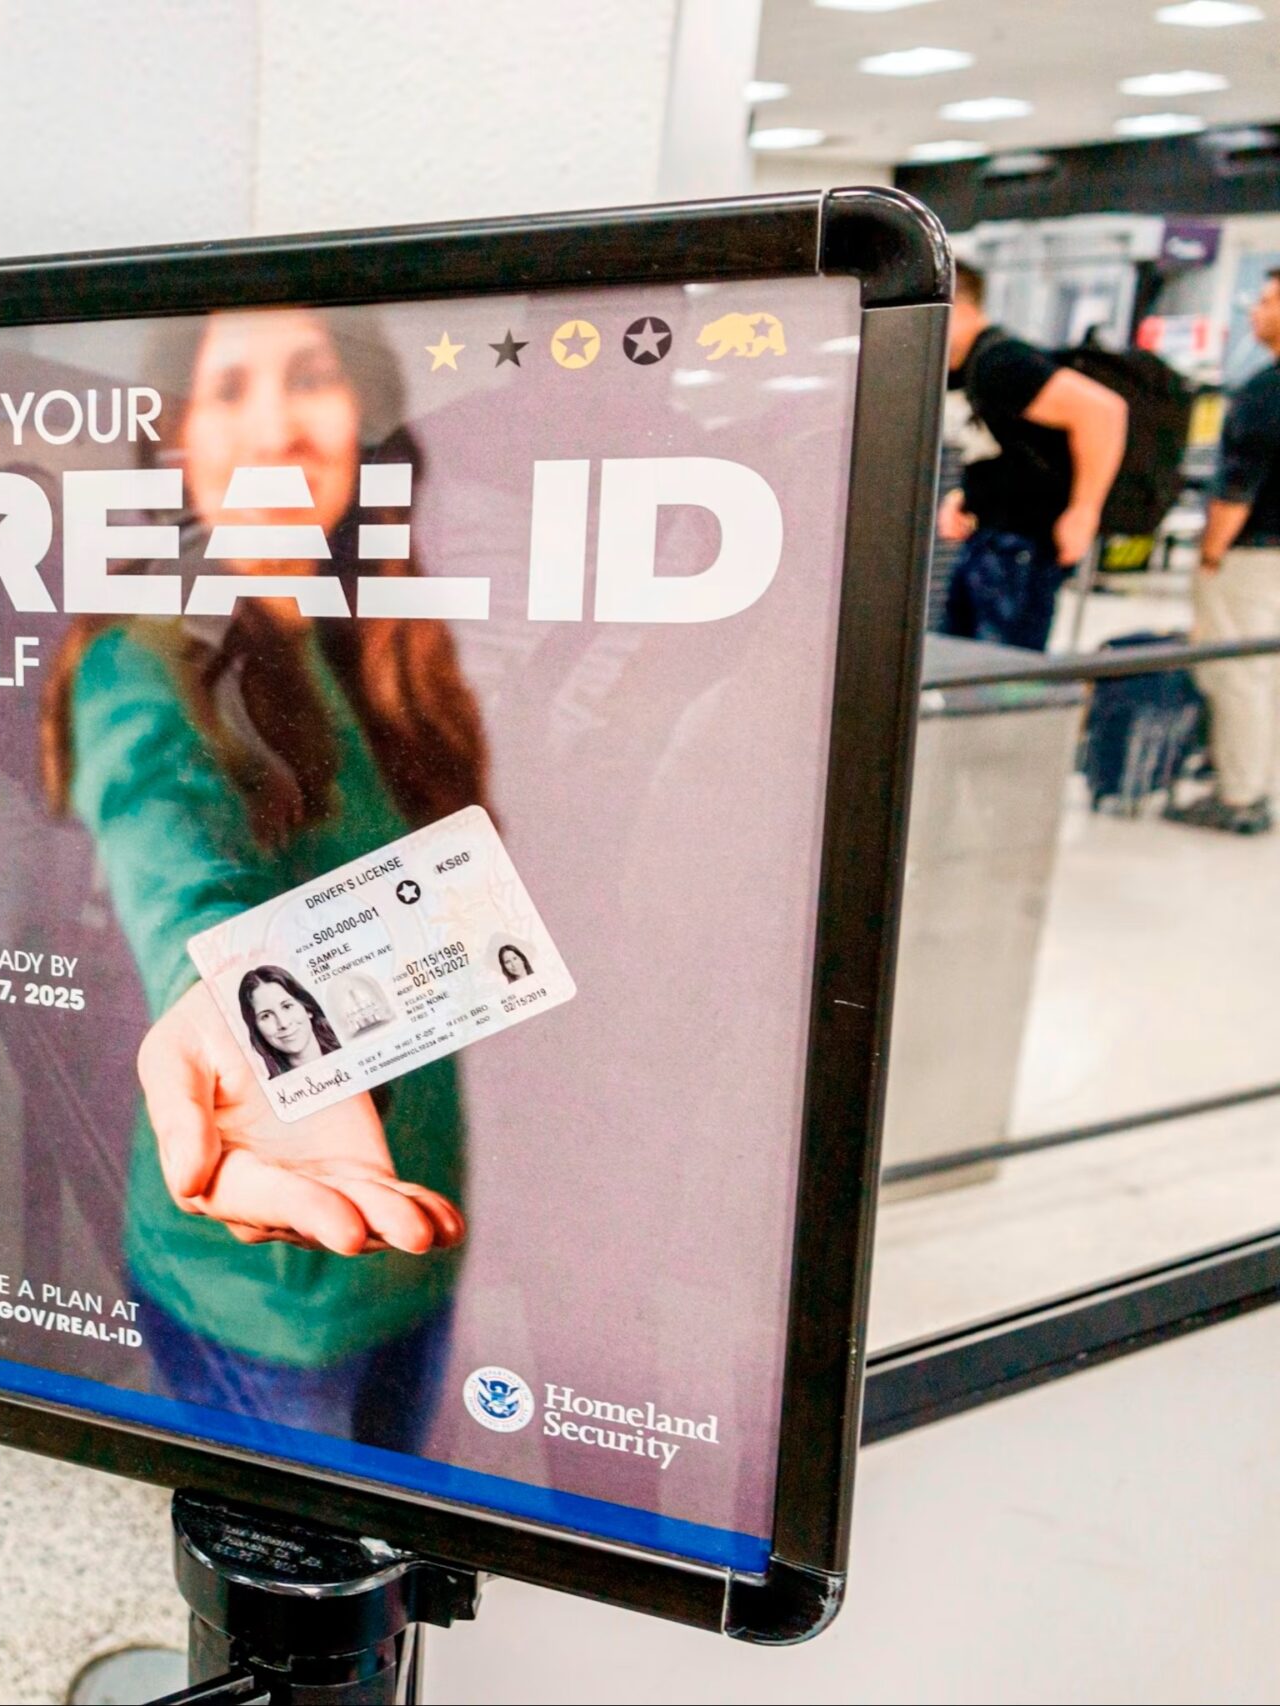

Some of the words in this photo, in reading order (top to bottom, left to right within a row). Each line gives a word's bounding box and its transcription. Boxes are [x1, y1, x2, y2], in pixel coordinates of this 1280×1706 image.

[0, 387, 162, 445] YOUR
[527, 457, 784, 624] ID
[435, 851, 470, 874] KS80
[304, 878, 356, 910] DRIVER'S
[355, 856, 404, 886] LICENSE
[312, 906, 380, 945] S00-000-001
[51, 955, 78, 978] BY
[308, 943, 352, 968] SAMPLE
[312, 962, 331, 975] KIM
[331, 951, 375, 976] CONFIDENT
[377, 944, 393, 956] AVE
[405, 941, 465, 976] 07/15/1980
[412, 953, 469, 988] 02/15/2027
[24, 983, 85, 1011] 2025
[425, 992, 448, 1005] NONE
[469, 1004, 489, 1017] BRO
[503, 987, 547, 1013] 02/15/2019
[17, 1279, 35, 1300] A
[42, 1283, 102, 1315] PLAN
[110, 1299, 140, 1322] AT
[543, 1383, 720, 1444] Homeland
[543, 1411, 680, 1470] Security
